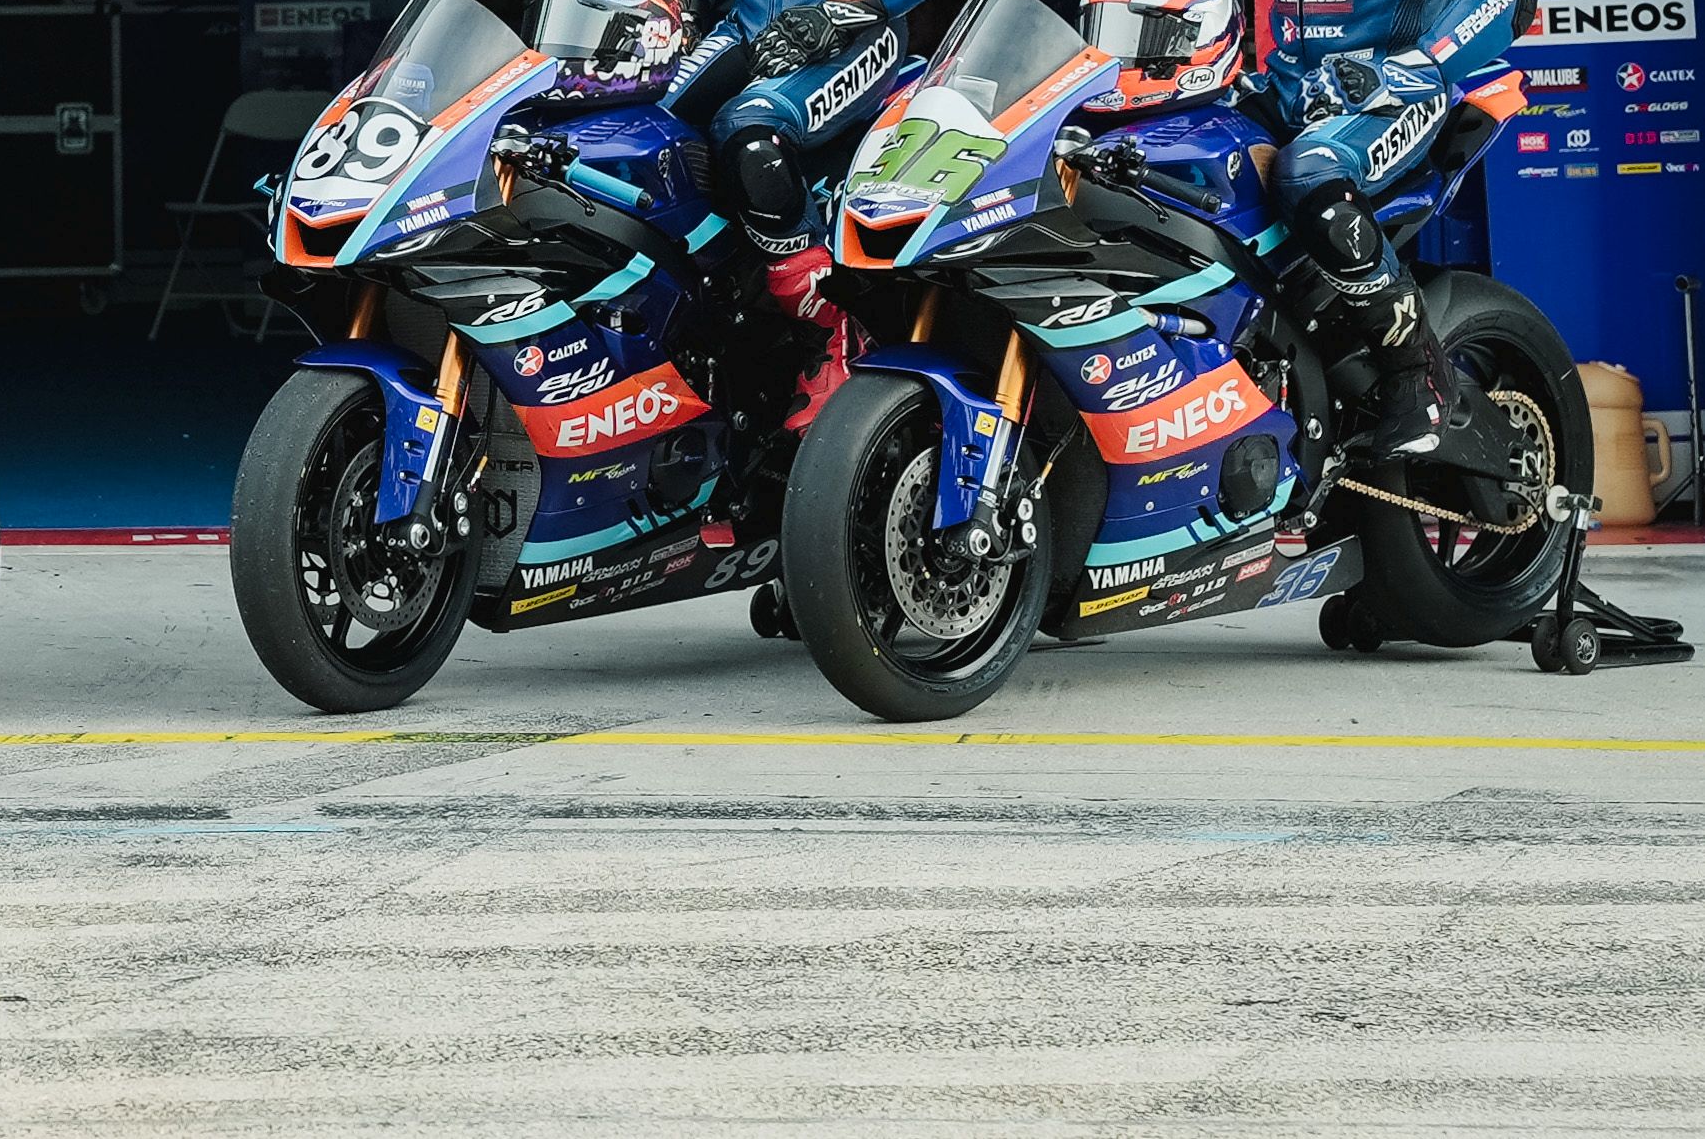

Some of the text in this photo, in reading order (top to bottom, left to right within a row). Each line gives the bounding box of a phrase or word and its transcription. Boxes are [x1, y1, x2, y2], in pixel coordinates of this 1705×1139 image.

[1548, 2, 1686, 34] ENEOS
[485, 62, 533, 94] ENEOS
[1049, 58, 1099, 94] ENEOS
[1183, 71, 1213, 87] Arai
[1649, 69, 1695, 82] CALTEX
[296, 111, 420, 182] 89
[846, 117, 1009, 205] 36
[397, 206, 450, 234] YAMAHA
[961, 204, 1017, 233] YAMAHA
[472, 289, 546, 326] R6
[1040, 294, 1117, 328] R6
[548, 338, 589, 362] CALTEX
[1115, 343, 1158, 370] CALTEX
[537, 357, 610, 393] BLU
[540, 370, 615, 404] CRU
[1102, 358, 1177, 400] BLU
[1107, 370, 1183, 411] CRU
[555, 382, 680, 448] ENEOS
[1125, 379, 1247, 453] ENEOS
[521, 556, 594, 590] YAMAHA
[704, 539, 779, 589] 89
[1088, 557, 1165, 590] YAMAHA
[1240, 560, 1270, 578] NGK
[1255, 547, 1342, 608] 36
